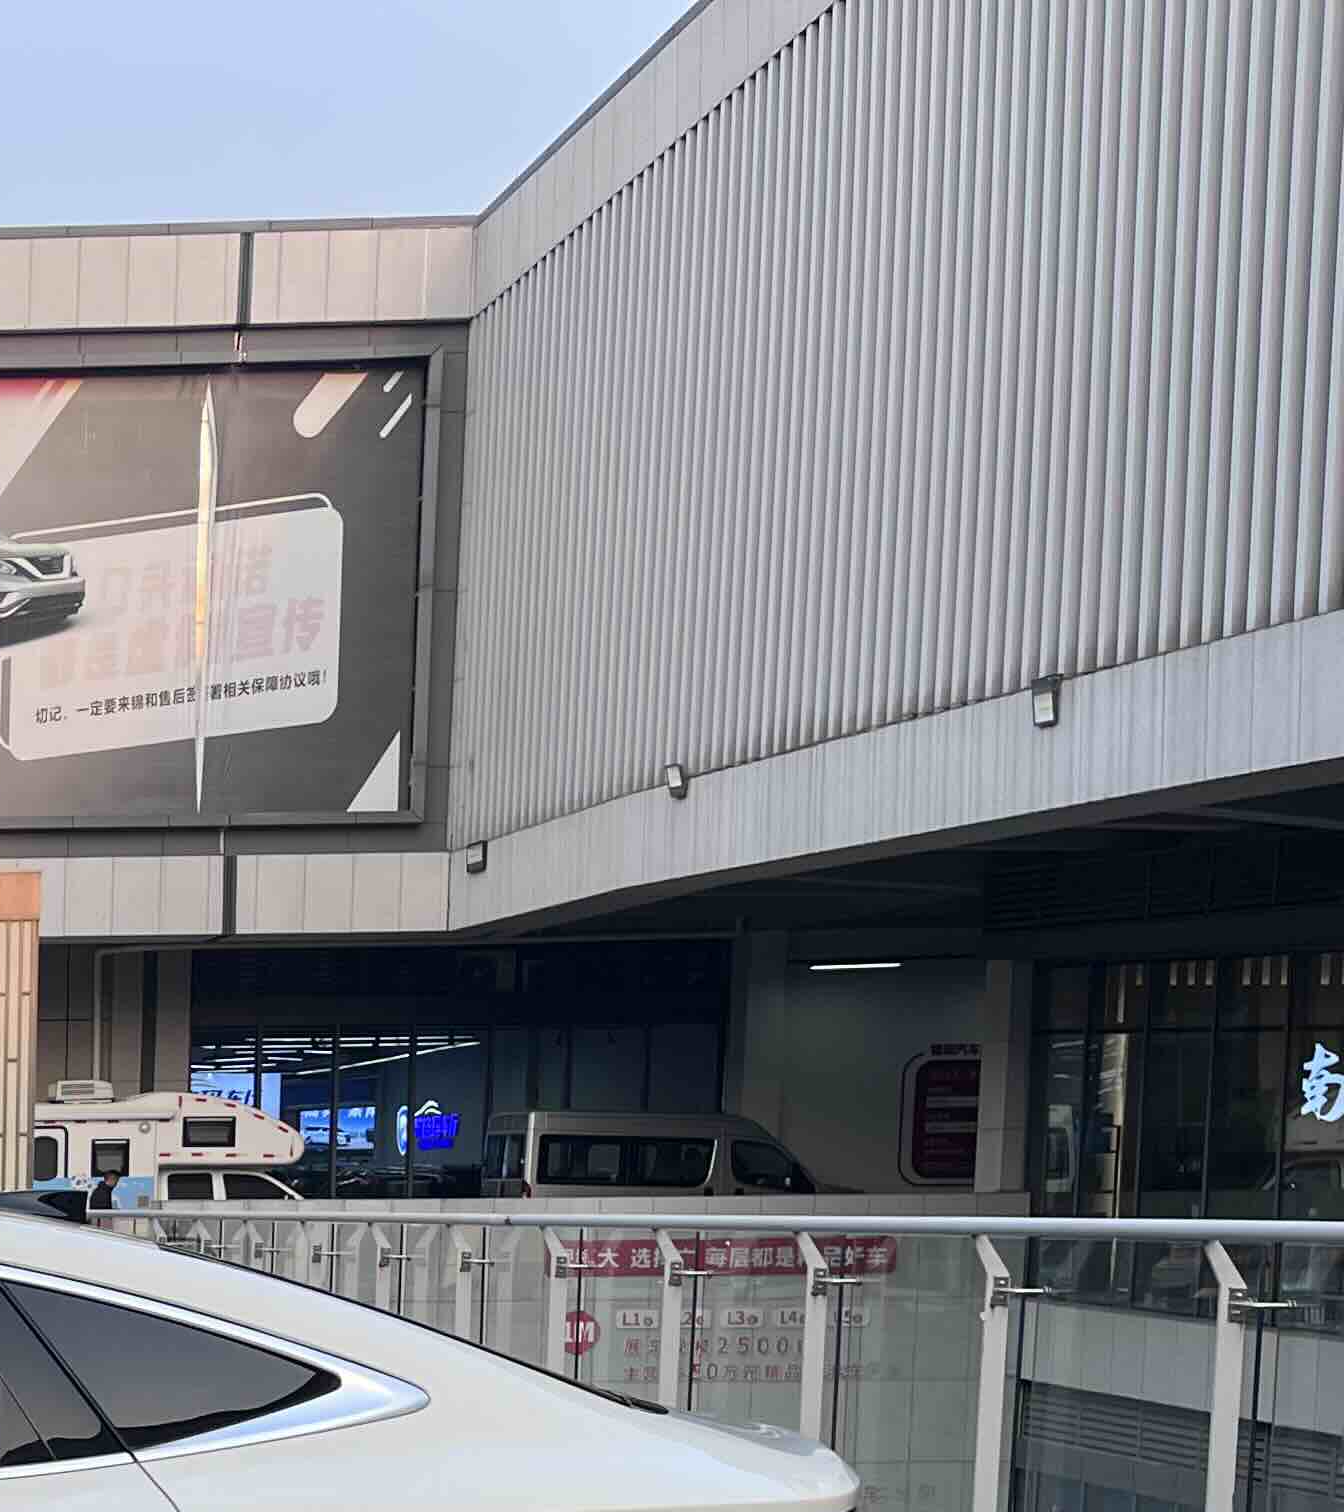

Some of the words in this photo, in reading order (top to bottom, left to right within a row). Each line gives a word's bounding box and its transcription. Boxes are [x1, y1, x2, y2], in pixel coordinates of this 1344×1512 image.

[704, 1246, 889, 1269] 每层都是品好车
